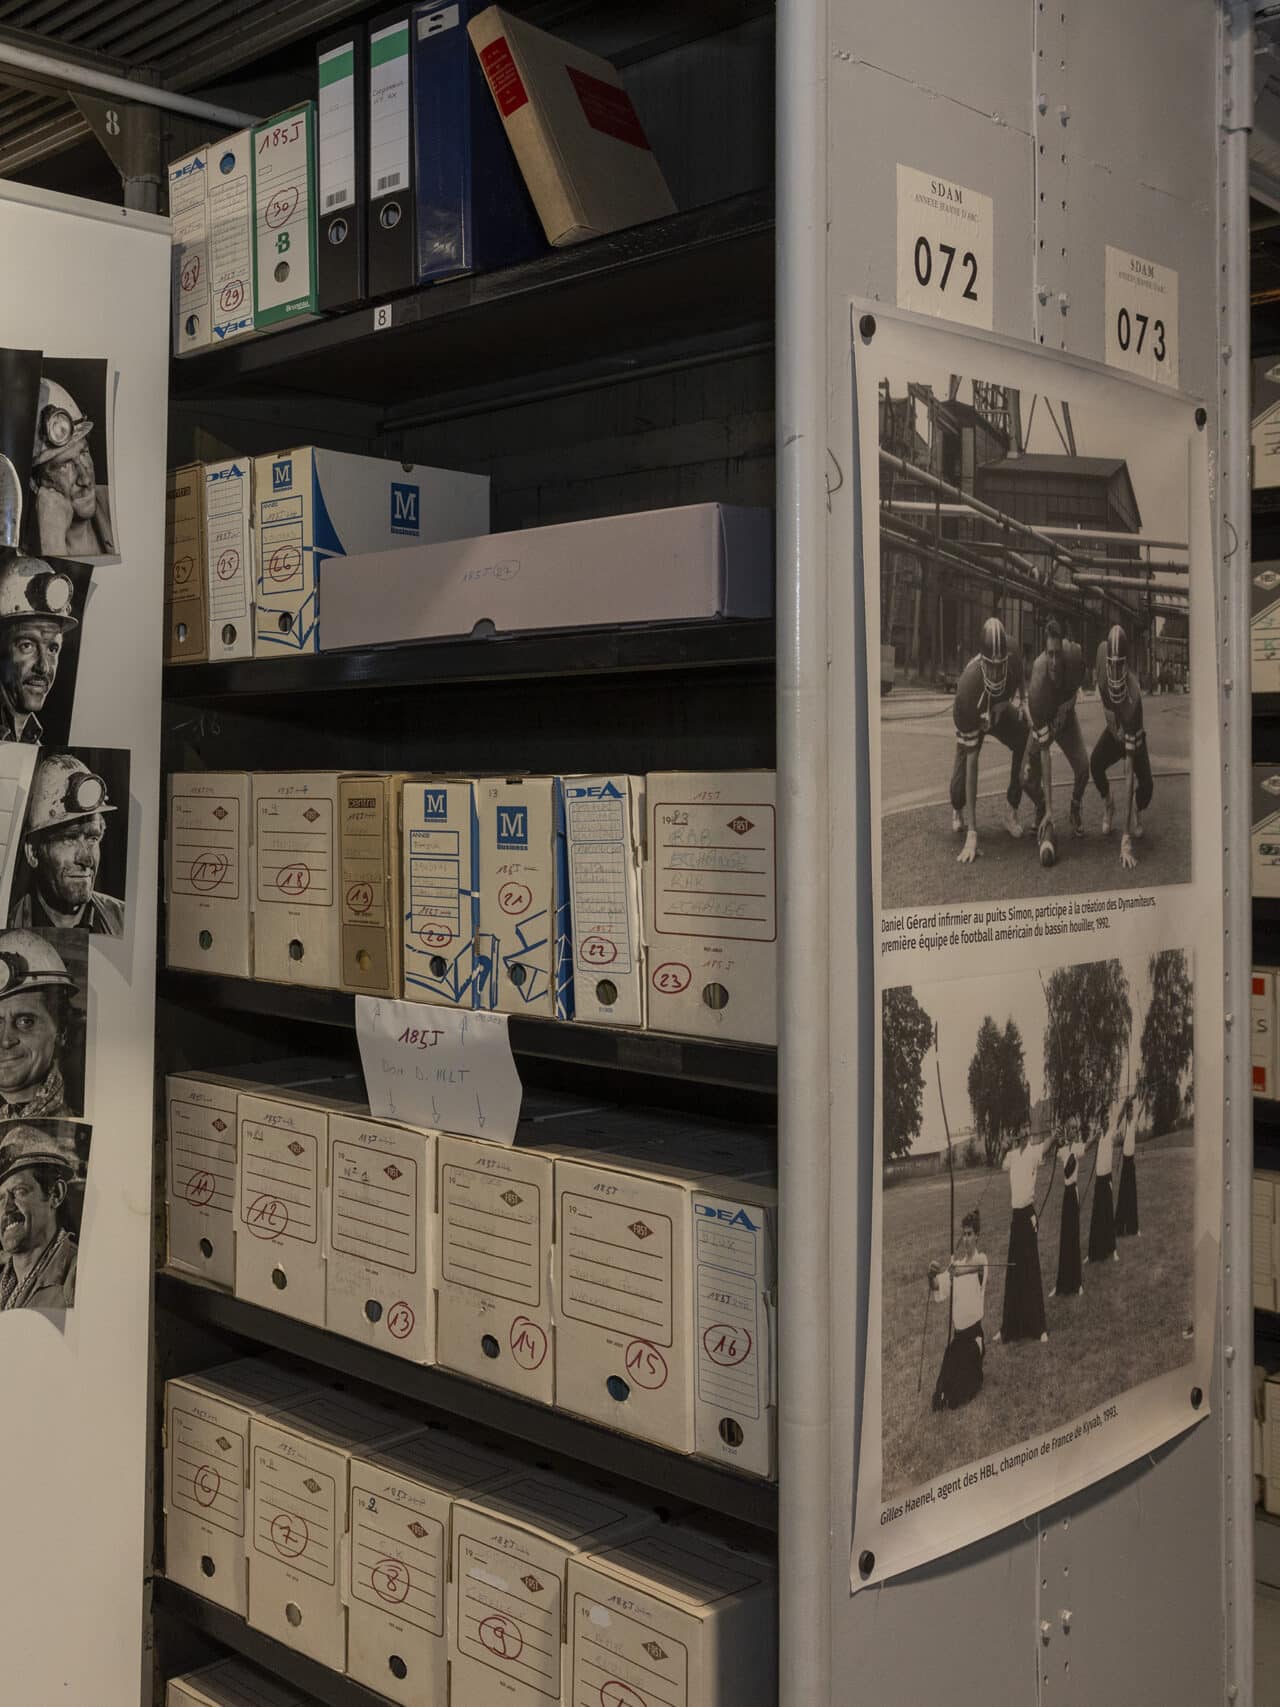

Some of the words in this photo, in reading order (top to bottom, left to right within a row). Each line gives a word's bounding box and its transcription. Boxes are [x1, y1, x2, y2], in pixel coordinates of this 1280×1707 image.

[106, 110, 121, 135] 8
[170, 157, 208, 181] DEA
[931, 180, 962, 205] SDAM
[914, 236, 978, 302] 072
[1130, 259, 1154, 280] SDAM
[377, 310, 388, 326] 8
[1117, 307, 1166, 362] 073
[207, 464, 246, 481] DEA
[393, 491, 417, 521] M
[567, 781, 627, 799] DEA
[426, 794, 445, 814] M
[500, 812, 524, 838] M
[881, 916, 904, 933] Daniel
[906, 912, 936, 930] Gérard
[939, 909, 971, 927] infirmier
[974, 912, 984, 924] au
[986, 907, 1007, 926] puits
[1009, 905, 1034, 923] Simon,
[1036, 902, 1067, 921] participe
[1068, 901, 1073, 915] à
[1075, 901, 1081, 914] la
[1082, 898, 1106, 913] création
[1107, 897, 1116, 910] des
[881, 935, 916, 957] première
[918, 932, 949, 951] équipe
[949, 931, 960, 945] de
[961, 927, 993, 944] football
[995, 923, 1033, 942] américain
[1034, 923, 1043, 937] du
[1045, 920, 1068, 935] bassin
[660, 973, 682, 988] 23
[398, 1027, 445, 1050] 185J
[568, 1204, 578, 1216] 19
[694, 1203, 762, 1232] DEA
[389, 1311, 410, 1332] 13
[513, 1330, 535, 1360] 14
[713, 1335, 737, 1357] 16
[628, 1349, 659, 1375] 15
[880, 1503, 903, 1526] Gilles
[905, 1488, 936, 1513] Haenel,
[937, 1478, 962, 1500] agent
[963, 1472, 978, 1488] des
[980, 1463, 998, 1481] HBL,
[1000, 1446, 1039, 1473] champion
[1040, 1441, 1051, 1456] de
[1051, 1431, 1074, 1450] France
[1074, 1425, 1083, 1439] de
